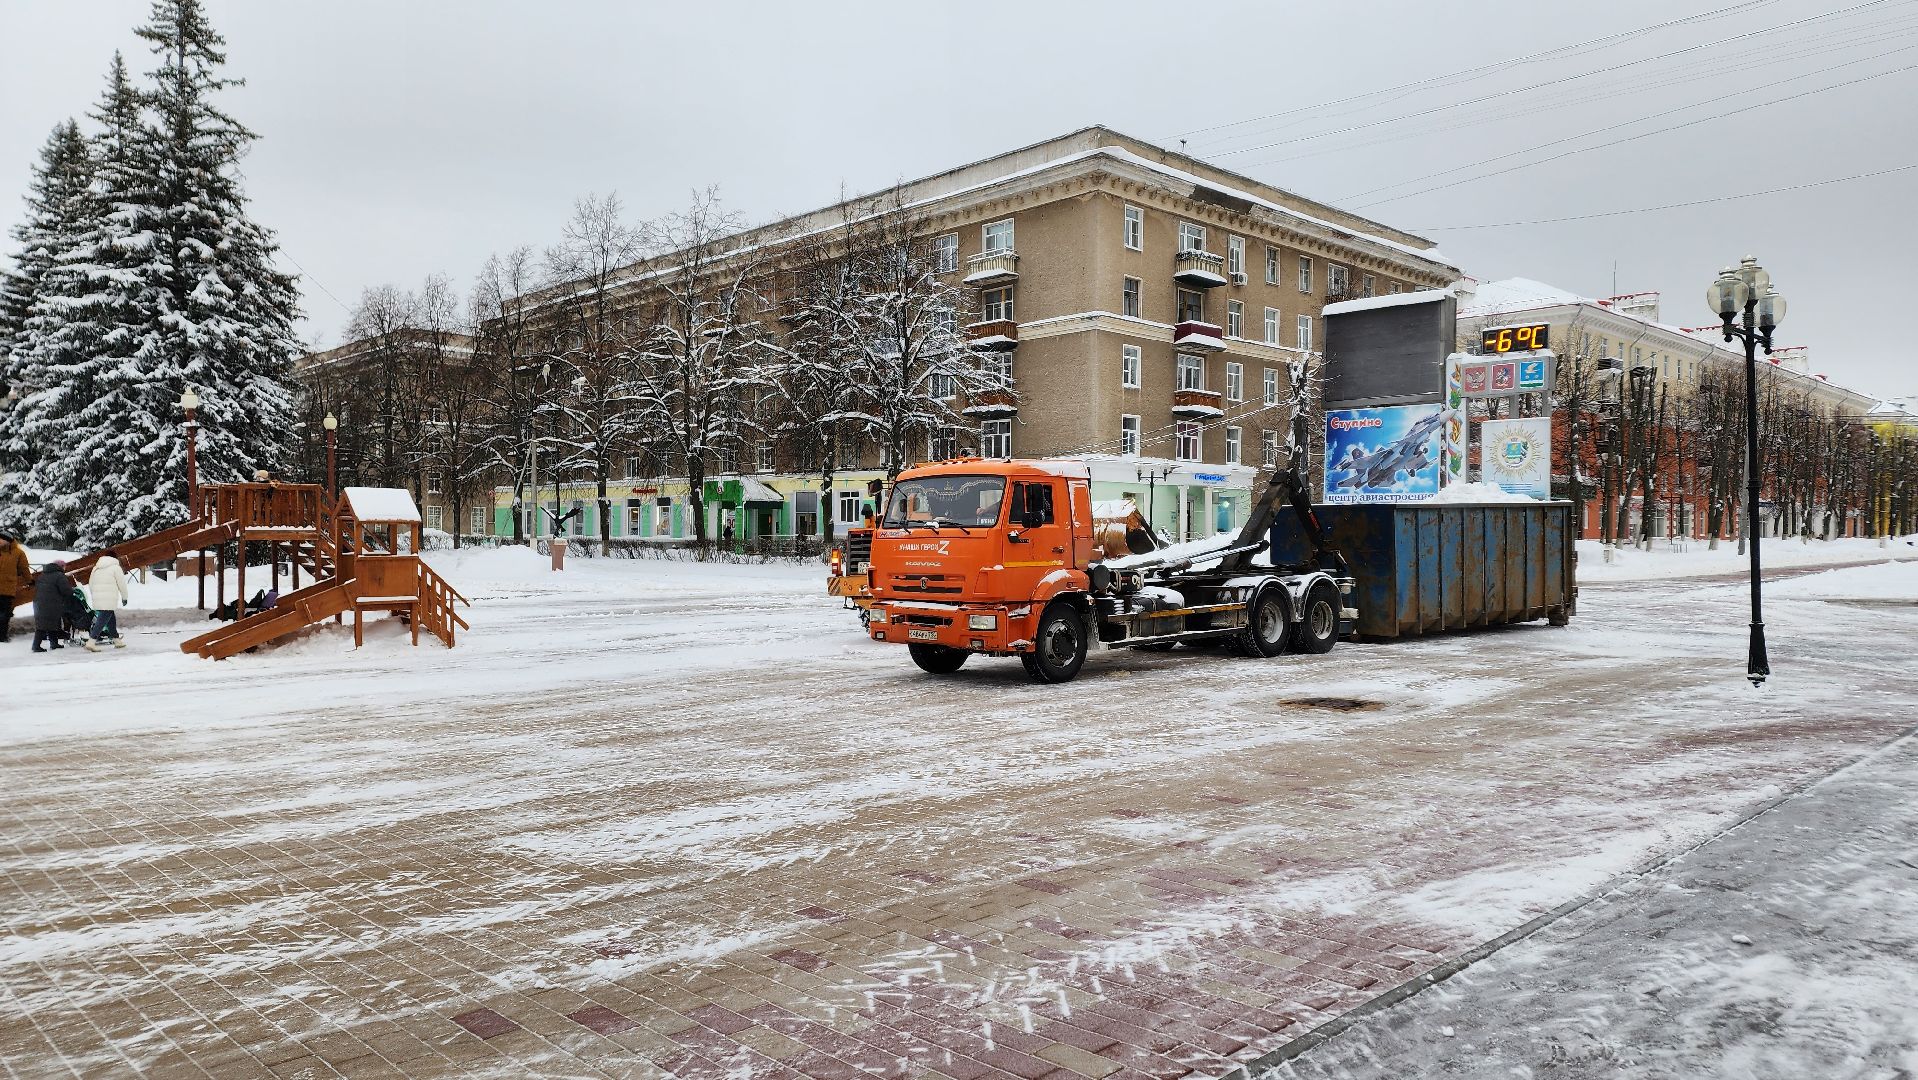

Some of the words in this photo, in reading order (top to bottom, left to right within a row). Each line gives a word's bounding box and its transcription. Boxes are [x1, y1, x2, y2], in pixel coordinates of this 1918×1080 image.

[1331, 417, 1382, 431] Ступино
[1328, 495, 1358, 503] центр
[938, 540, 950, 555] Z
